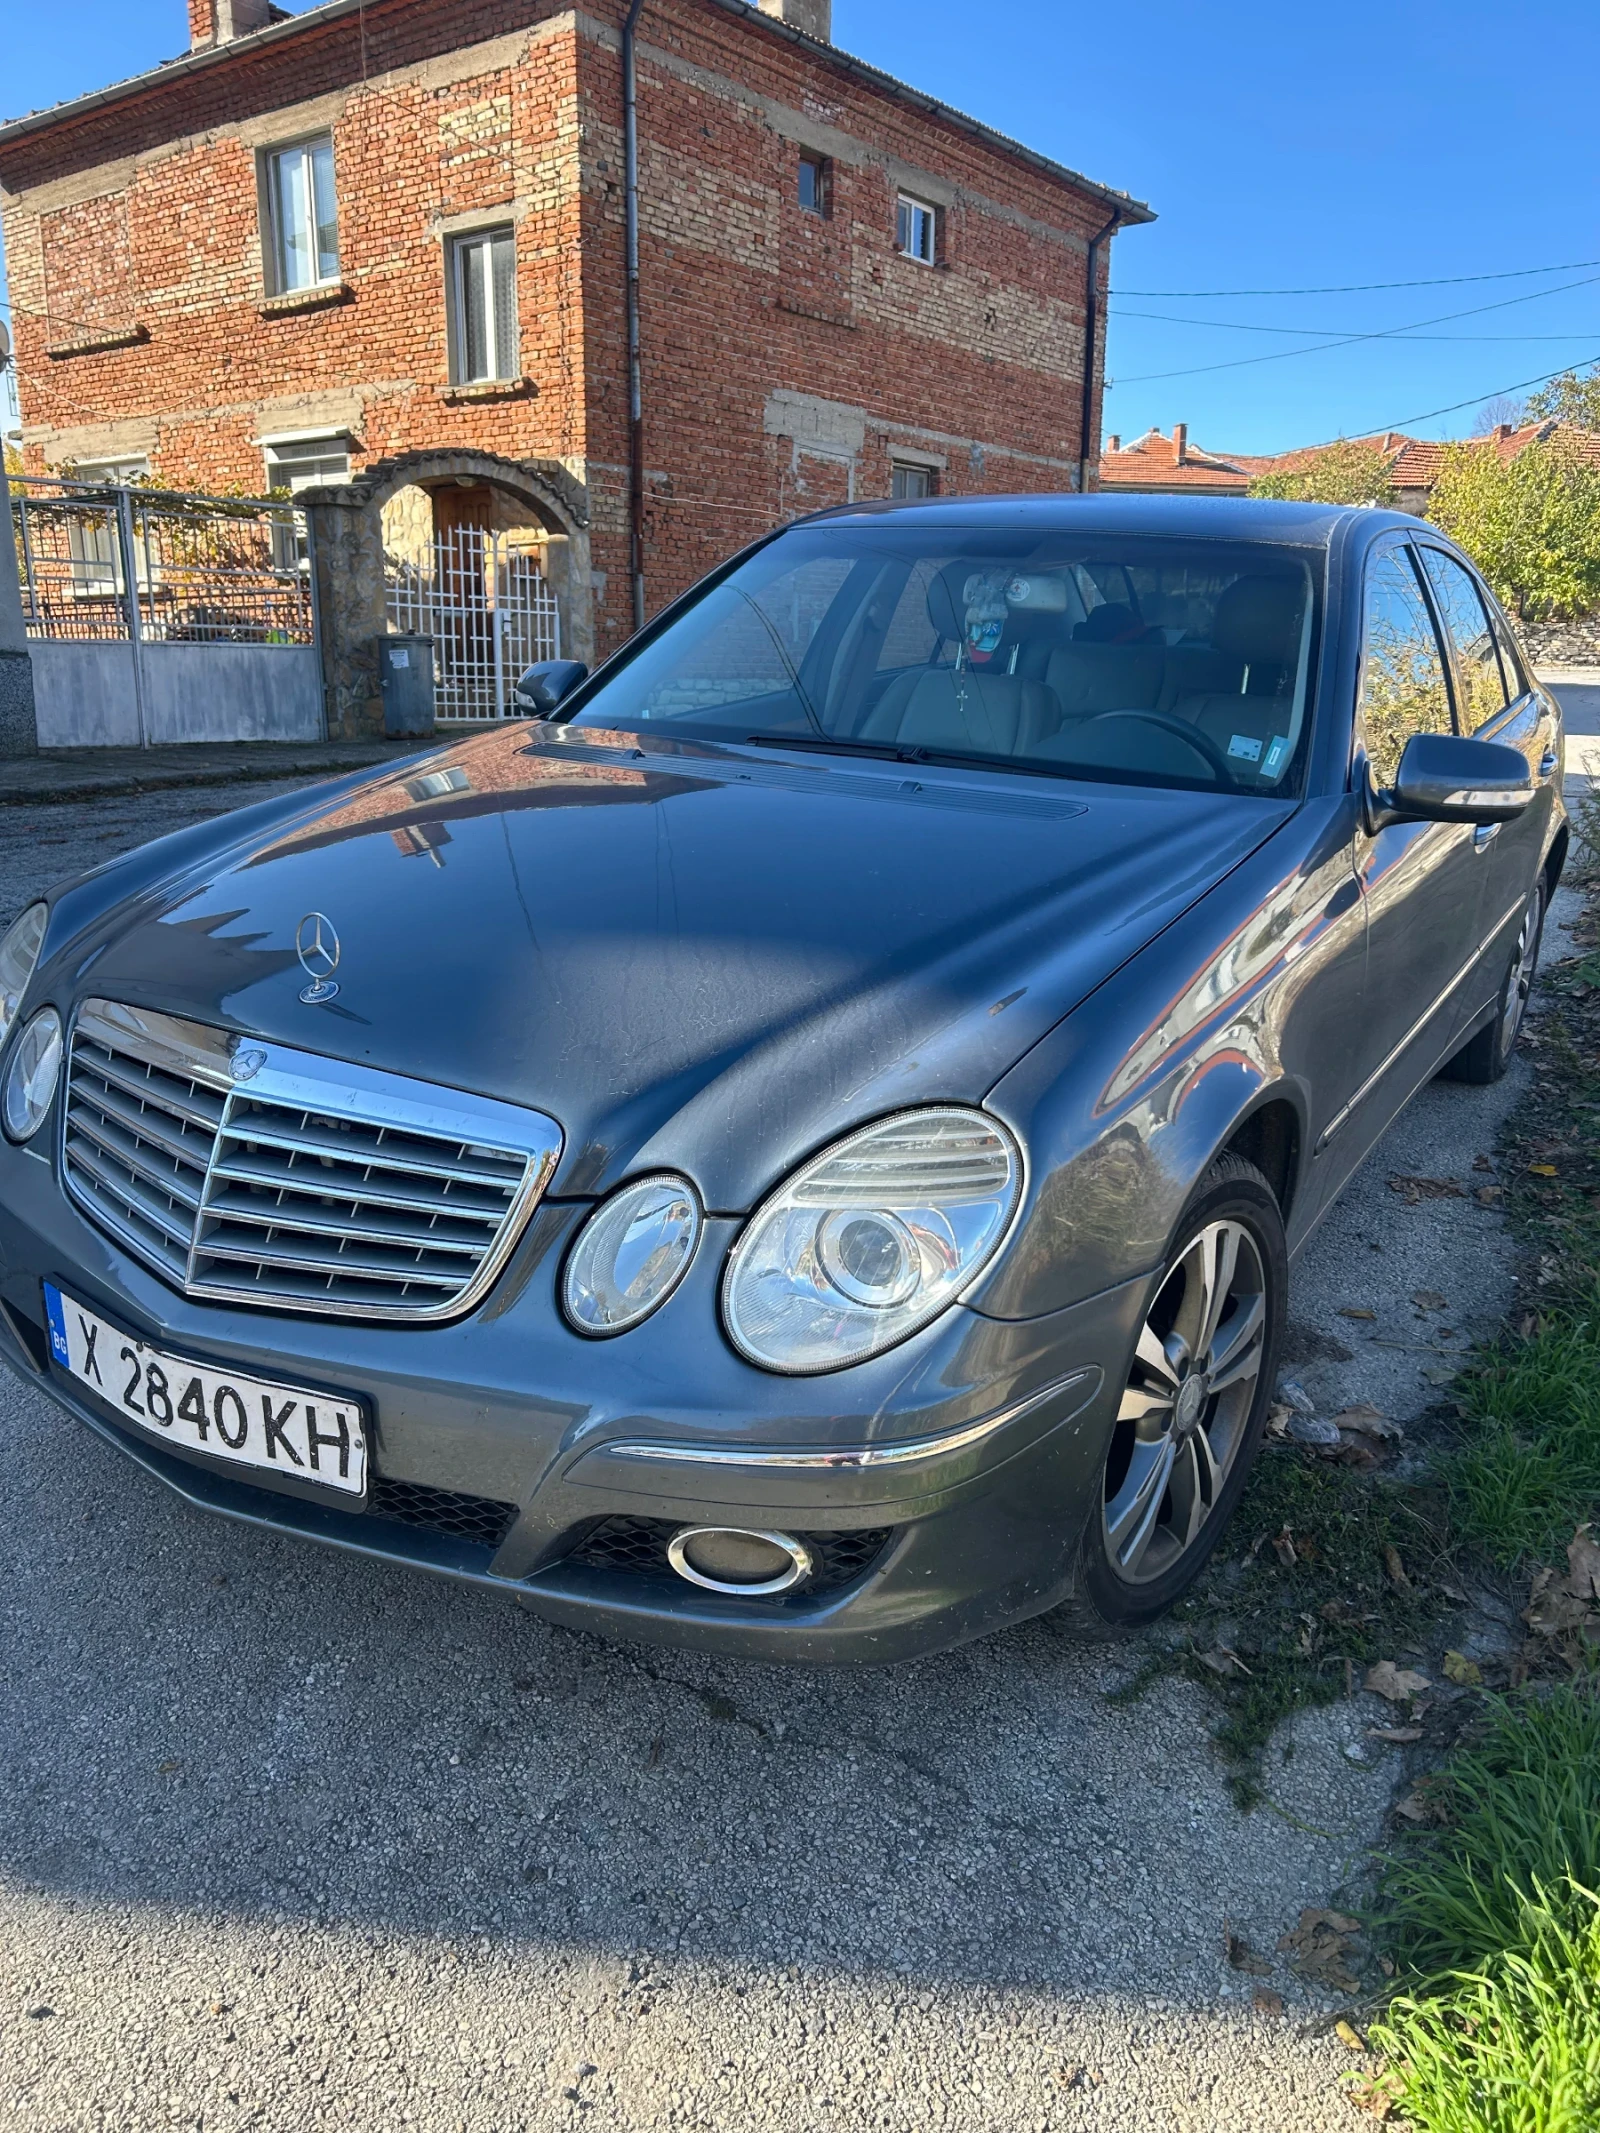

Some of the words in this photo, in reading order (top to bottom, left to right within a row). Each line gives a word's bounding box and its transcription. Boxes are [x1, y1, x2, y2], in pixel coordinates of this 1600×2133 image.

[53, 1330, 67, 1355] BG
[78, 1313, 103, 1387] X
[120, 1346, 248, 1449] 2840
[261, 1395, 350, 1478] KH
